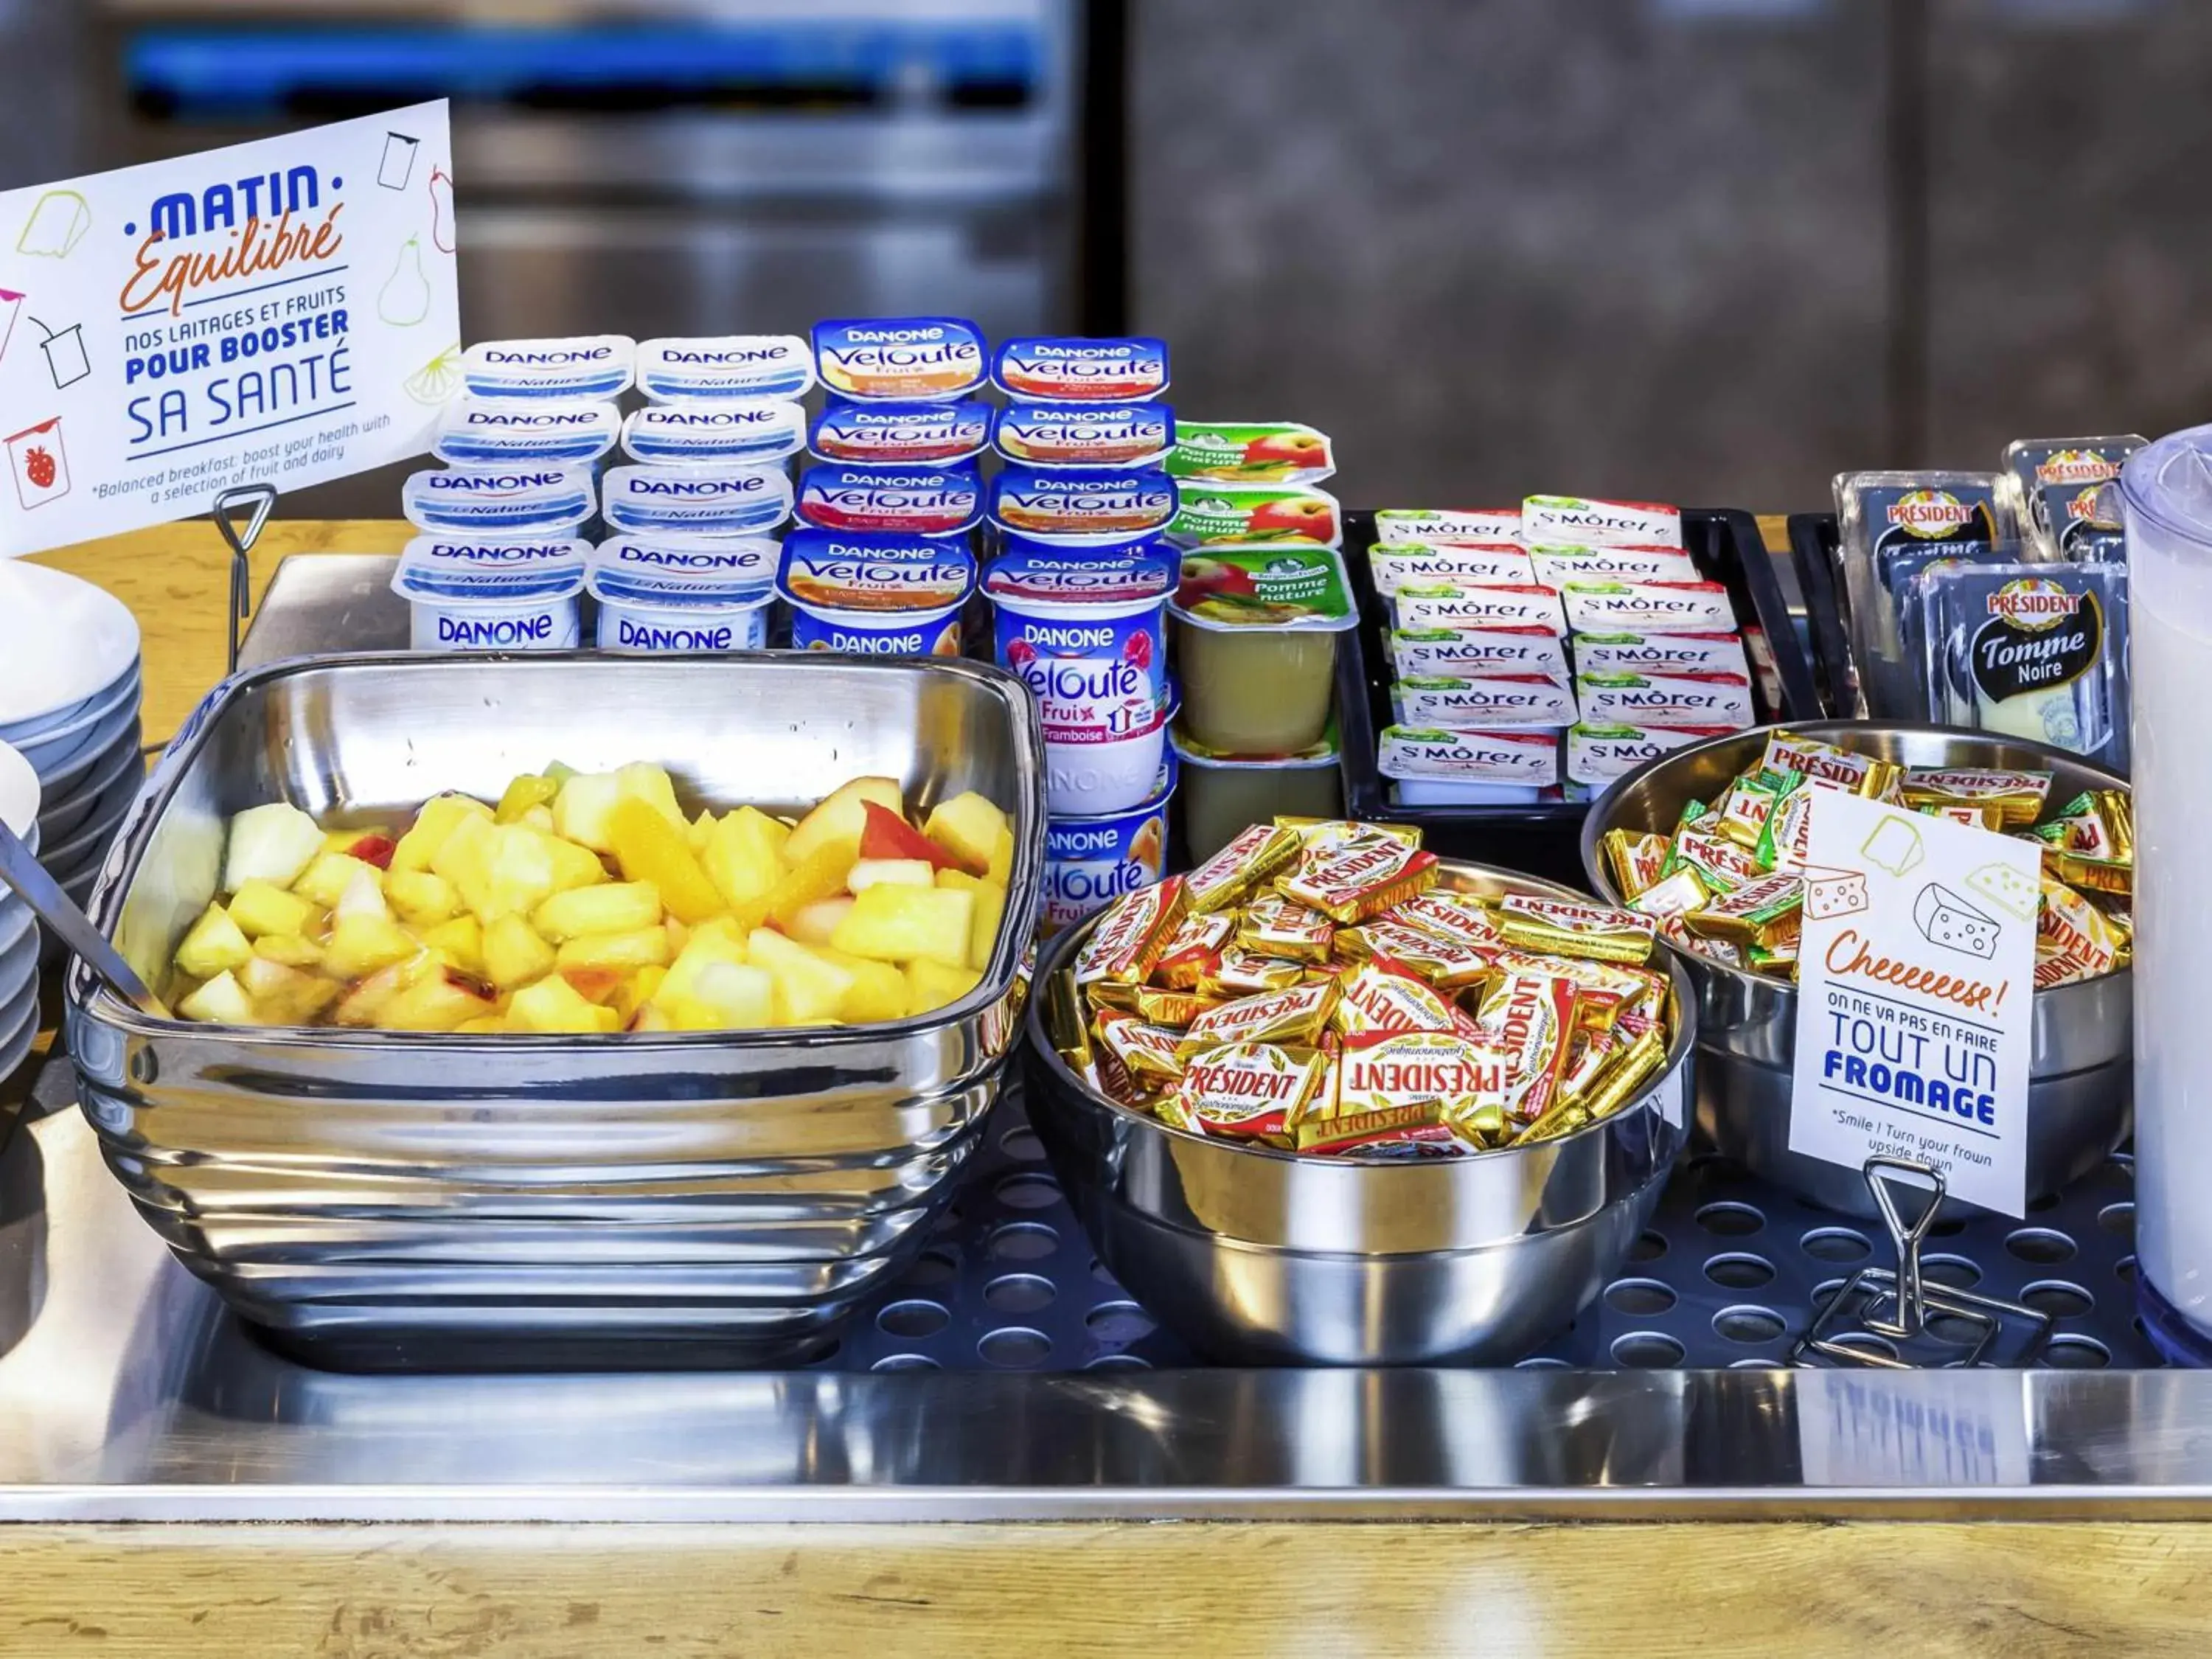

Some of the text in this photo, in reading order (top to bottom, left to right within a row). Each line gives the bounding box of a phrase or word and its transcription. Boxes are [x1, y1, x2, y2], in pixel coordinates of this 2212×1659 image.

[150, 165, 319, 243] MATIN
[125, 286, 345, 352] NOS LAITAGES ET FRUITS
[848, 328, 944, 342] DANONE
[126, 309, 348, 384] POUR BOOSTER
[484, 347, 612, 364] DANONE
[664, 347, 788, 363] DANONE
[823, 341, 975, 365] Velouté
[1035, 346, 1131, 358] DANONE
[1009, 355, 1160, 376] Velouté
[127, 338, 351, 444] SA SANTÉ
[468, 412, 599, 425] DANONE
[647, 411, 775, 425] DANONE
[855, 411, 956, 423] DANONE
[1033, 410, 1133, 421] DANONE
[243, 442, 280, 464] boost
[285, 436, 313, 456] your
[318, 422, 358, 446] health
[363, 414, 390, 433] with
[828, 421, 982, 440] Velouté
[1007, 421, 1161, 439] Velouté
[150, 445, 345, 504] a selection of fruit and dairy
[430, 473, 563, 490] DANONE
[841, 473, 945, 486] DANONE
[1035, 479, 1138, 490] DANONE
[630, 477, 764, 494] DANONE
[812, 484, 973, 507] Velouté
[470, 503, 541, 514] Nature
[1006, 490, 1169, 509] Velouté
[669, 507, 737, 518] Nature
[1889, 503, 1972, 524] PRÉSIDENT
[432, 545, 571, 560] DANONE
[620, 546, 760, 567] DANONE
[829, 544, 935, 560] DANONE
[799, 555, 967, 582] Velouté
[1028, 560, 1135, 570] DANONE
[462, 573, 535, 584] Nature
[651, 579, 727, 591] Nature
[1000, 568, 1165, 585] Velouté
[1255, 579, 1327, 593] Pomme
[1260, 588, 1326, 602] nature
[1988, 592, 2079, 616] PRÉSIDENT
[439, 614, 552, 644] DANONE
[619, 620, 731, 649] DANONE
[1025, 625, 1114, 647] DANONE
[833, 633, 921, 653] DANONE
[1981, 631, 2086, 669] Tomme
[2018, 663, 2062, 684] Noire
[1048, 829, 1119, 850] ANONE
[1047, 855, 1141, 900] louté
[1828, 991, 1997, 1053] ON NE VA PAS EN FAIRE
[1829, 1011, 1997, 1092] TOUT UN
[1181, 1065, 1297, 1099] PRÉSIDENT
[1350, 1061, 1500, 1098] PRÉSIDENT
[1824, 1050, 1995, 1126] FROMAGE
[1868, 1139, 1912, 1159] upside
[1886, 1123, 1915, 1143] Turn
[1919, 1137, 1950, 1154] your
[1953, 1144, 1992, 1166] frown
